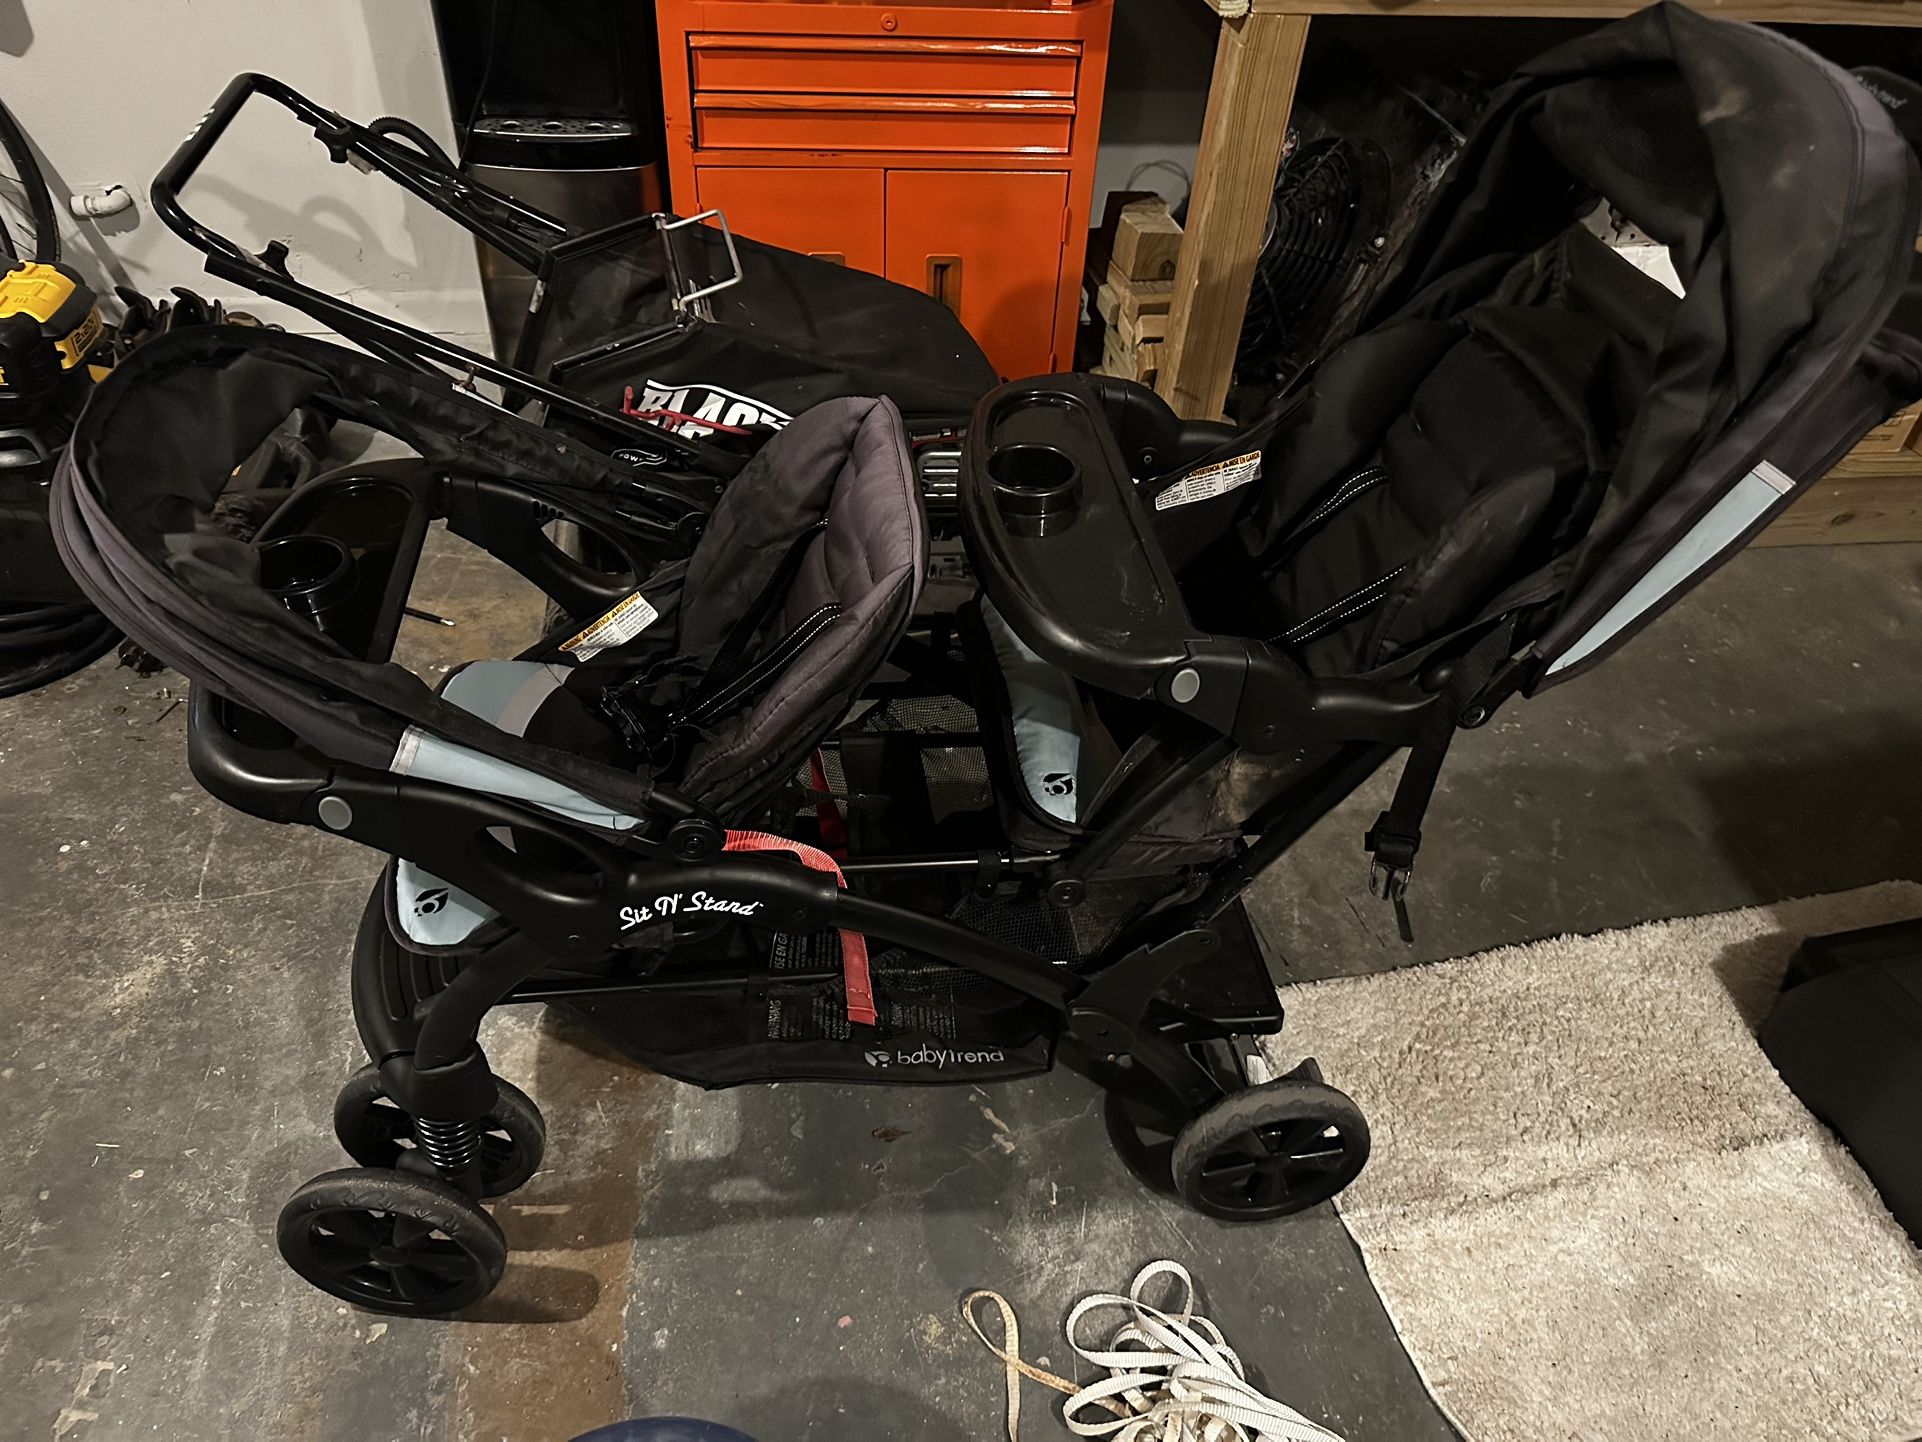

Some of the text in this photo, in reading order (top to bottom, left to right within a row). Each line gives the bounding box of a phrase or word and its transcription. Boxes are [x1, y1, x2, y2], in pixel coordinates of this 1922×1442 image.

[1228, 457, 1239, 468] MISE
[1246, 451, 1260, 463] GARDE
[619, 906, 653, 931] Sit
[683, 891, 759, 916] Stand
[775, 943, 786, 956] EN
[897, 1042, 1005, 1070] babytrend
